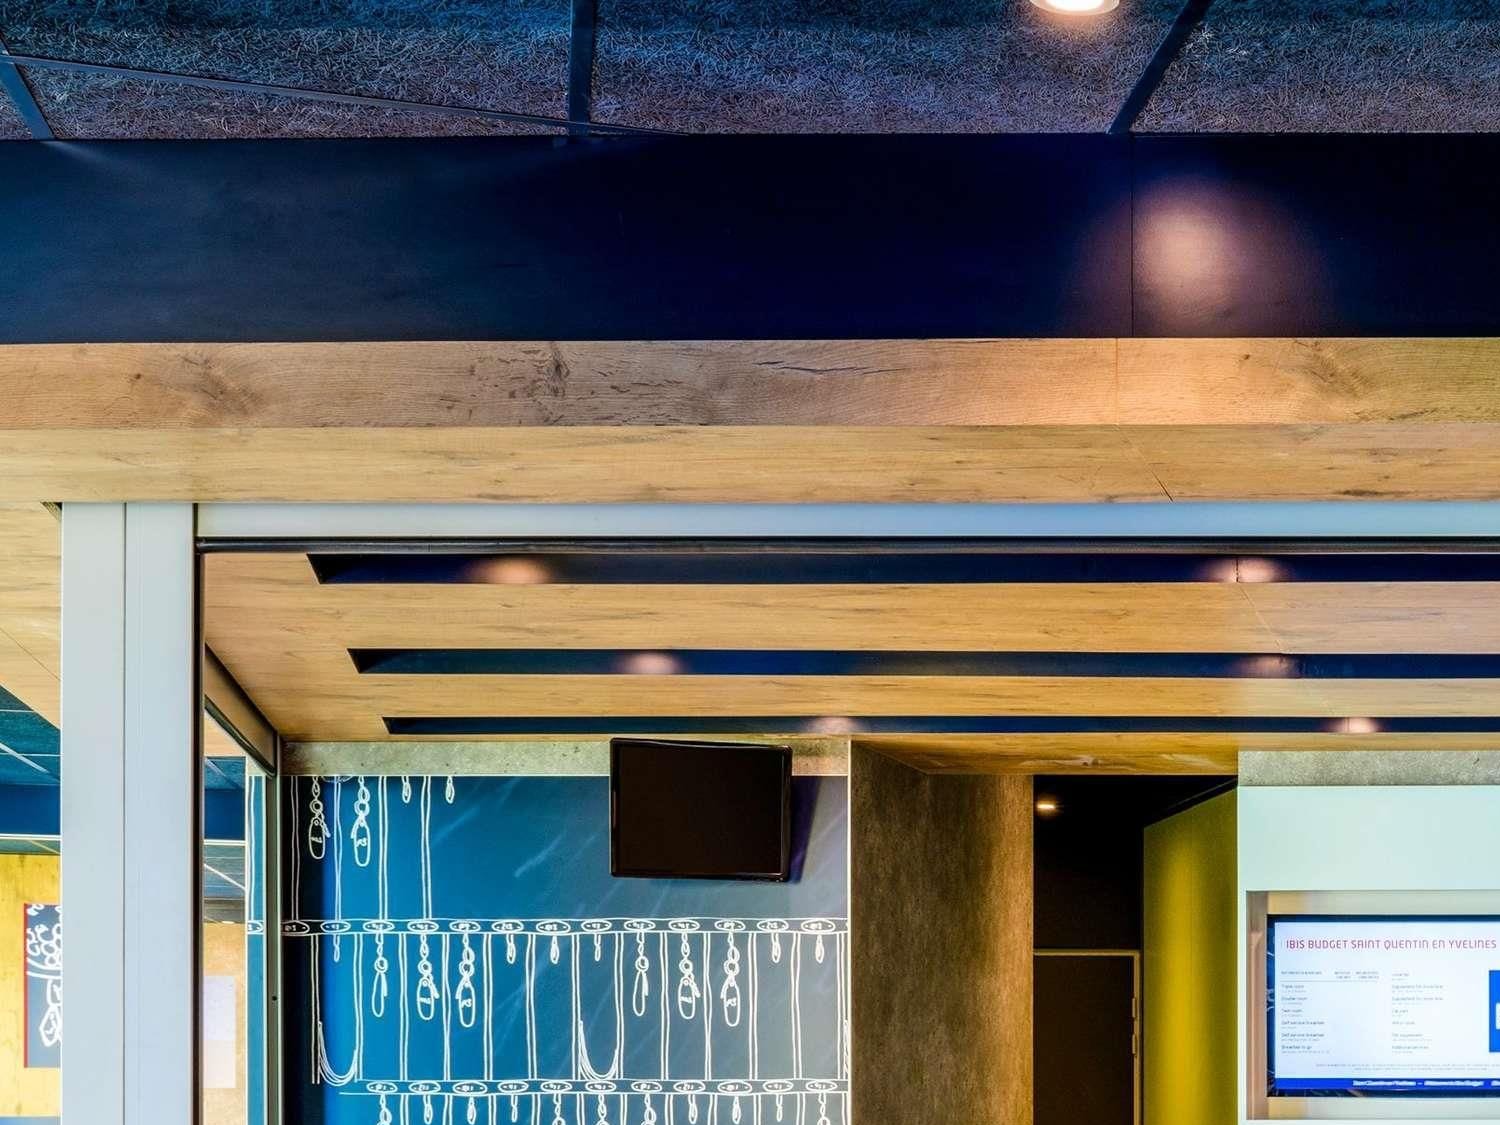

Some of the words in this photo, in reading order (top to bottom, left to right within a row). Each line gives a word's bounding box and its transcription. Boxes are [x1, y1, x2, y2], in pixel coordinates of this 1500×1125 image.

[1286, 939, 1305, 949] IBIS
[1308, 939, 1348, 949] BUDGET
[1351, 939, 1380, 949] SAINT
